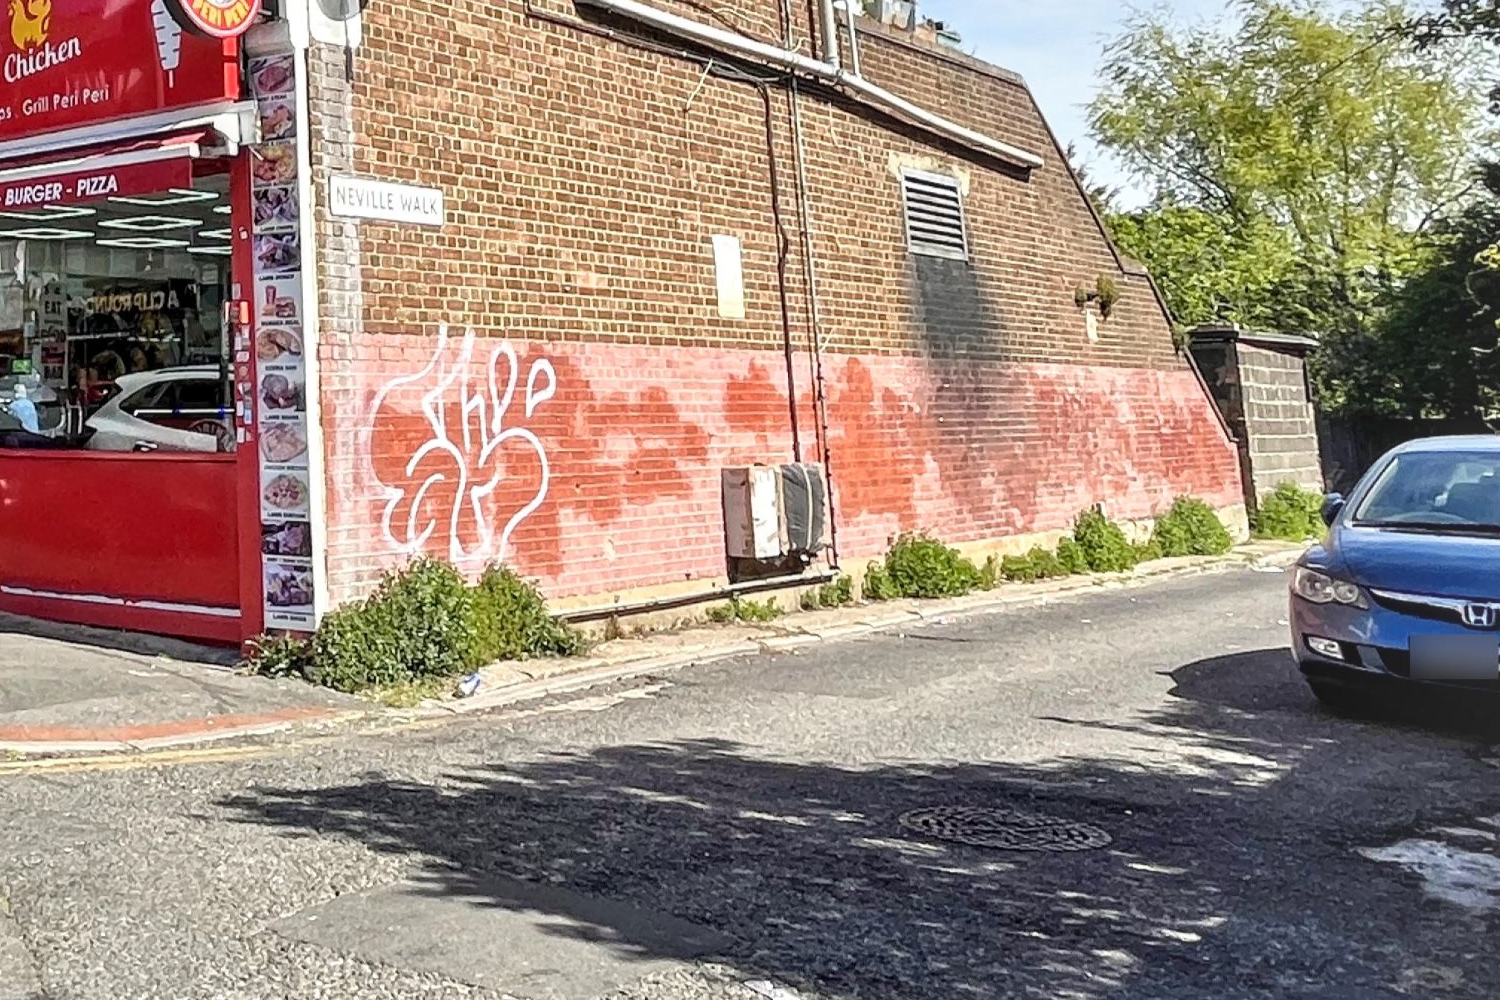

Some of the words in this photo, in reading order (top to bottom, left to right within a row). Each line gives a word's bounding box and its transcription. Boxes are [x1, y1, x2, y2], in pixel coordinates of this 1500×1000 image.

[4, 36, 81, 83] Chicken
[22, 96, 49, 116] Grill
[53, 91, 78, 110] Peri
[83, 83, 109, 105] Peri
[4, 182, 63, 206] BURGER
[76, 174, 118, 197] PIZZA
[336, 186, 395, 211] NEVILLE
[400, 193, 438, 215] WALK
